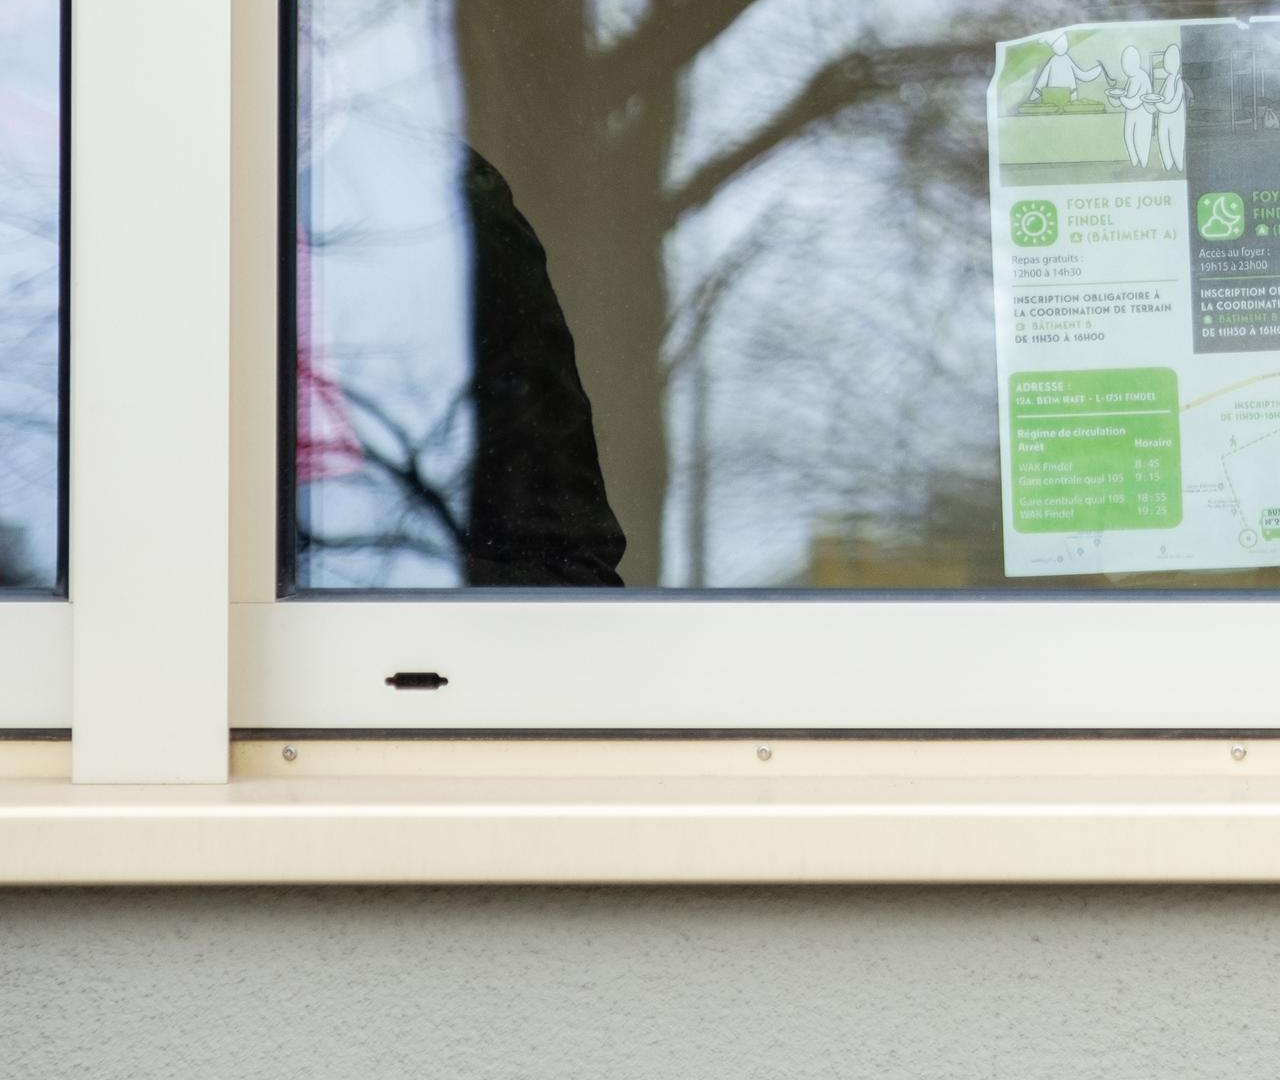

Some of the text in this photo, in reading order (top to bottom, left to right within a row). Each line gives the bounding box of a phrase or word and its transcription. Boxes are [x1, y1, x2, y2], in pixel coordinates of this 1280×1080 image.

[1067, 195, 1172, 210] FOYER DE JOUR
[1068, 215, 1114, 227] FINDEL
[1163, 229, 1177, 240] A)
[1199, 248, 1225, 258] Accès
[1228, 249, 1239, 257] au
[1242, 247, 1264, 257] foyer
[1012, 256, 1040, 265] Repas
[1042, 255, 1078, 265] gratuits
[1200, 261, 1267, 271] 19h15 à 23h00
[1013, 268, 1082, 278] 12h00 à 14h30
[1014, 290, 1160, 305] INSCRIPTION OBLIGATOIRE À
[1201, 287, 1265, 298] INSCRIPTION
[1014, 304, 1172, 317] LA COORDINATION DE TERRAIN
[1201, 303, 1213, 311] LA
[1202, 328, 1215, 337] DE
[1250, 324, 1255, 335] À
[1015, 336, 1028, 344] DE
[1064, 332, 1070, 342] À
[1016, 382, 1063, 392] ADRESSE
[1125, 392, 1157, 401] FINDEL
[1017, 426, 1126, 439] Régime de circulation
[1135, 438, 1172, 448] Horaire
[1043, 462, 1072, 471] Findel
[1019, 474, 1124, 487] Gare centrale quai 105
[1020, 497, 1041, 506] Gare
[1084, 496, 1105, 505] quai
[1044, 510, 1074, 518] Findel
